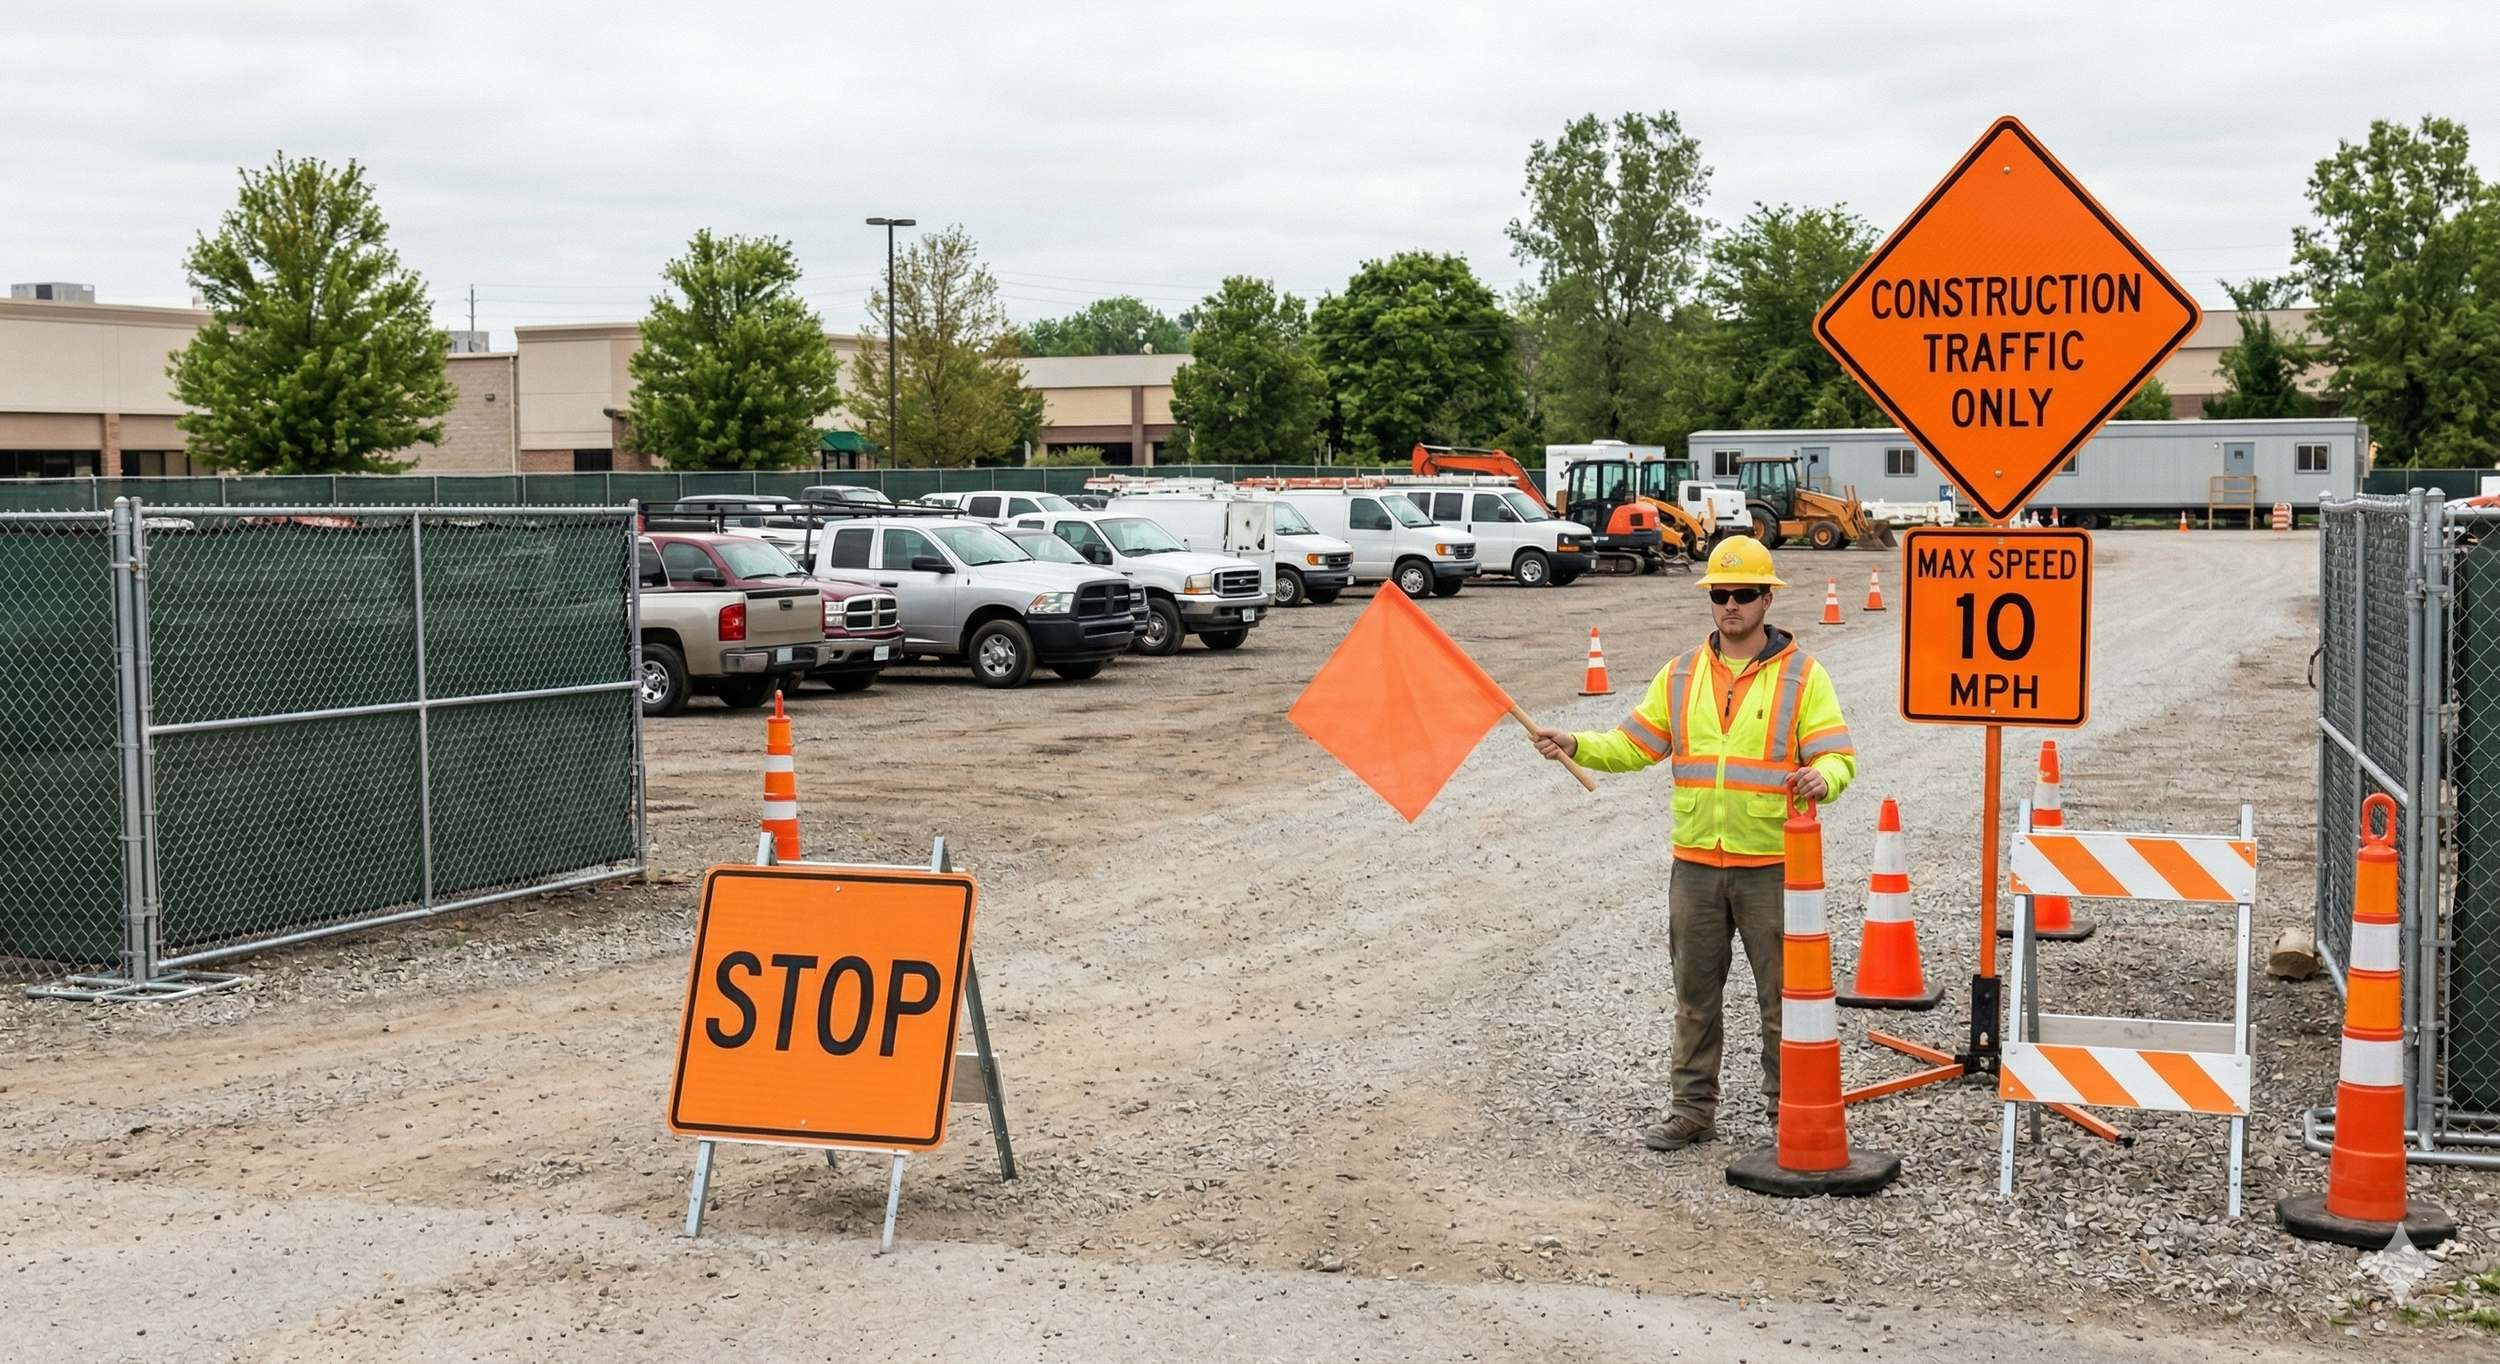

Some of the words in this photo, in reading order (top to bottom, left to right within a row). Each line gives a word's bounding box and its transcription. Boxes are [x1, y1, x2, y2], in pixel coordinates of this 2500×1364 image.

[1871, 272, 2141, 320] CONSTRUCTION
[1923, 330, 2084, 373] TRAFFIC
[1951, 388, 2053, 428] ONLY
[1918, 548, 1975, 579] MAX
[1988, 548, 2077, 580] SPEED
[1956, 592, 2036, 662] 10
[1950, 673, 2038, 709] MPH
[705, 950, 942, 1058] STOP
